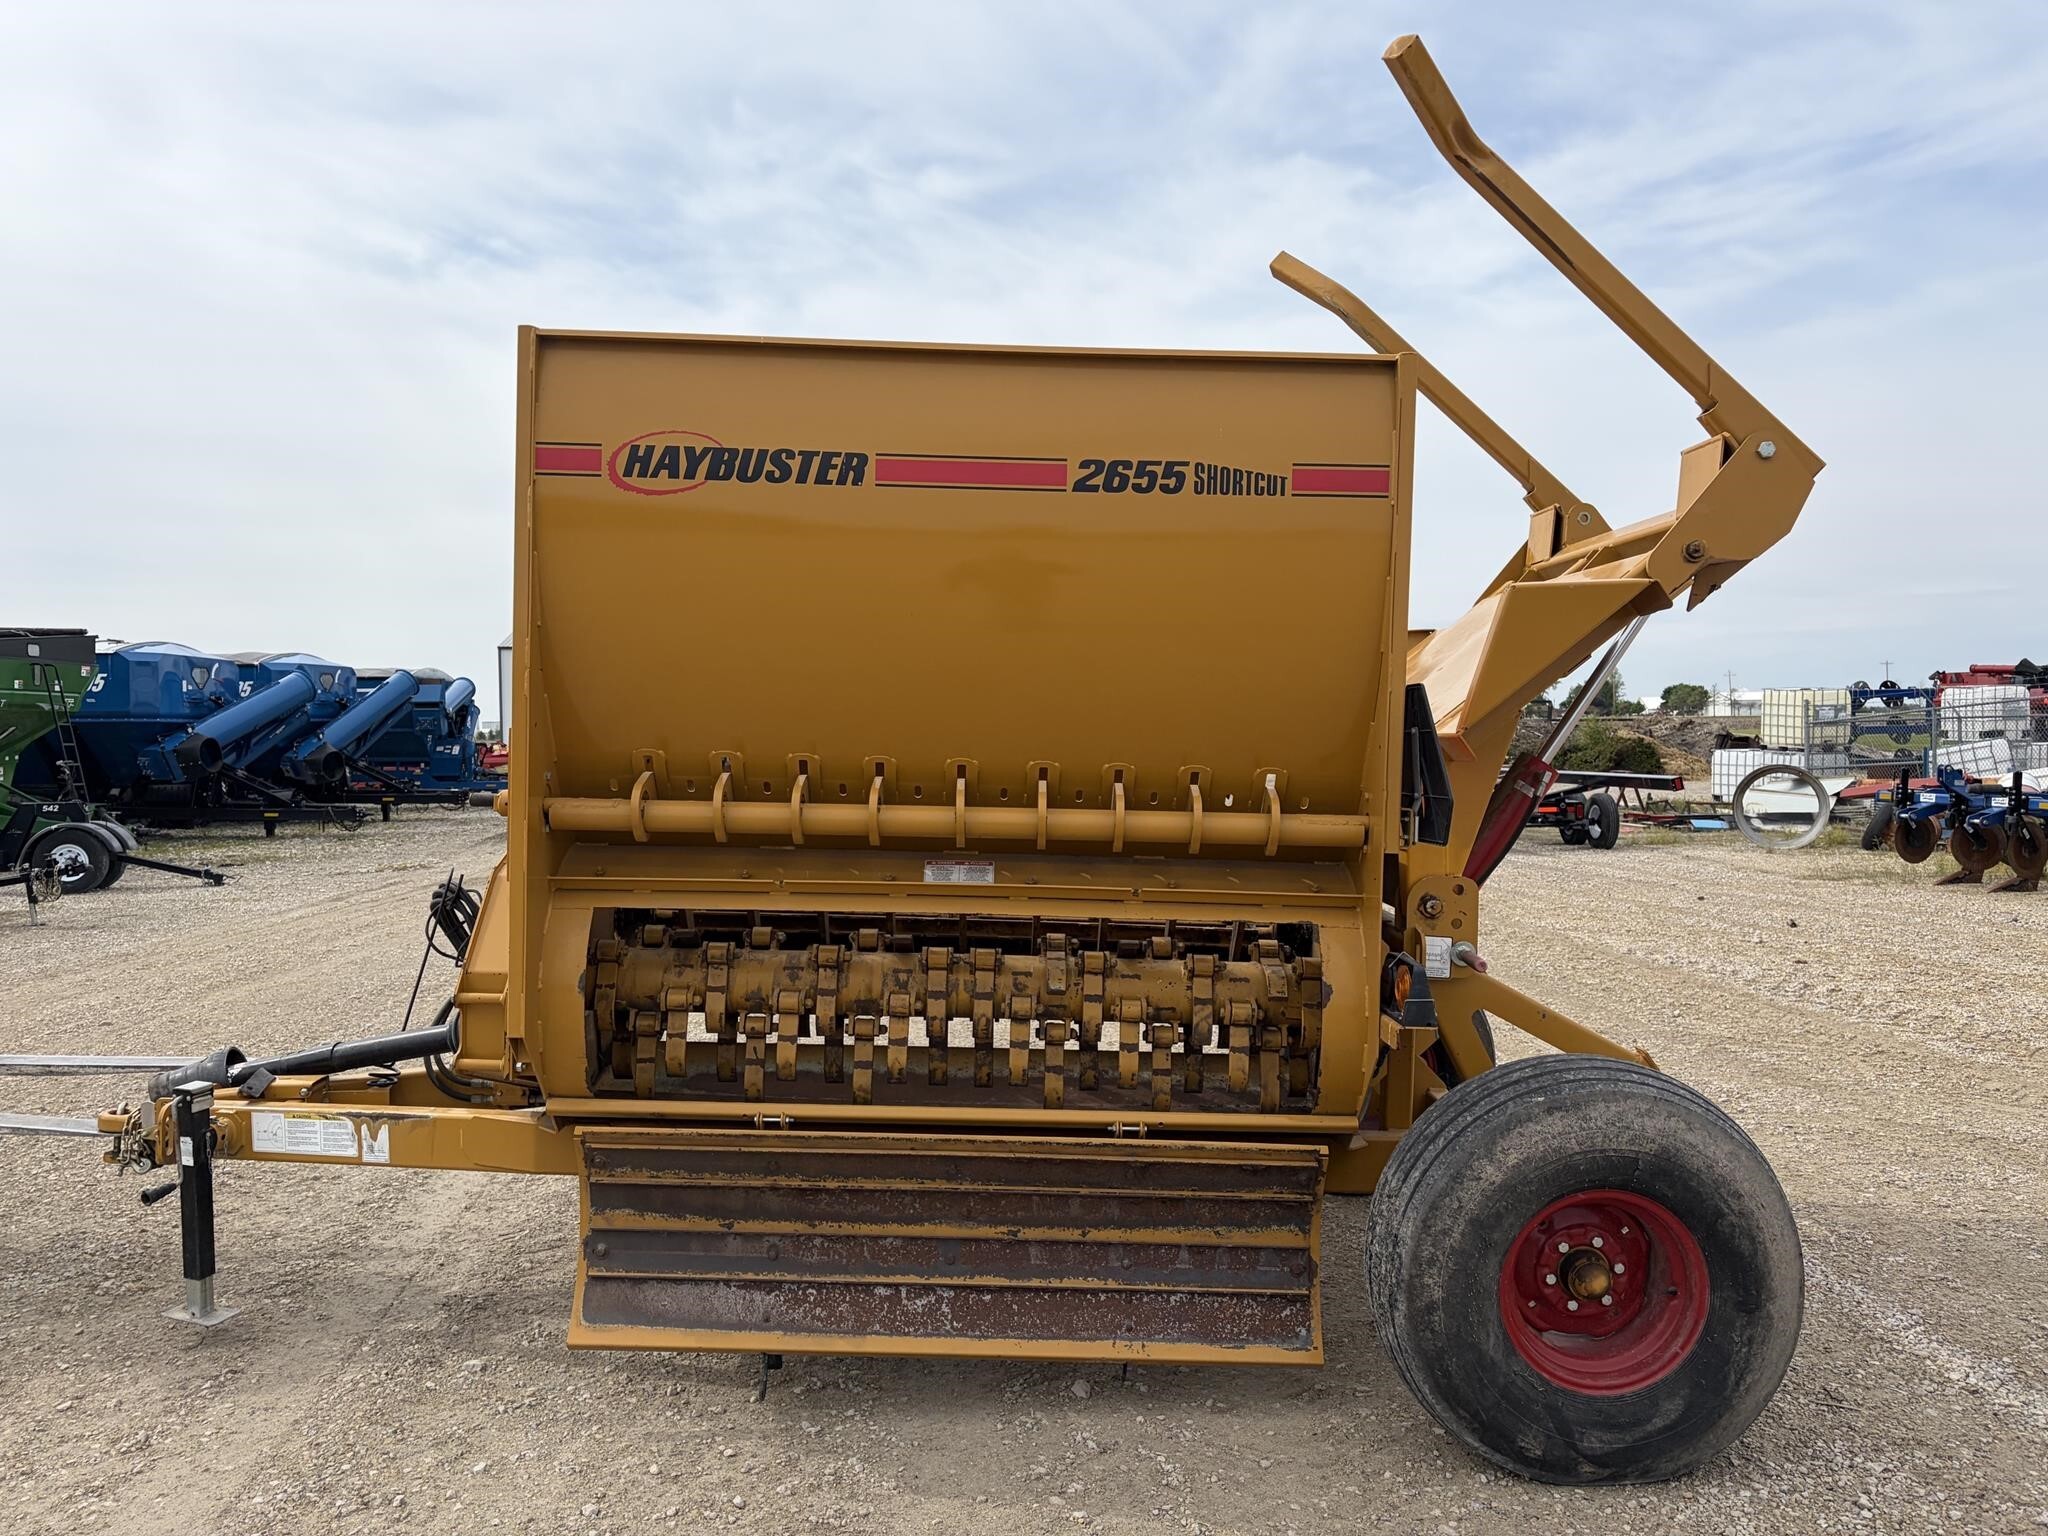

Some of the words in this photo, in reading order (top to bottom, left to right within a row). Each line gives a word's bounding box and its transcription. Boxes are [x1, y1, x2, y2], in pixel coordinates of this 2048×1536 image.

[622, 444, 869, 486] HAYBUSTER
[1071, 459, 1190, 494] 2655
[1193, 462, 1289, 496] SHORTCUT
[42, 804, 60, 812] 542
